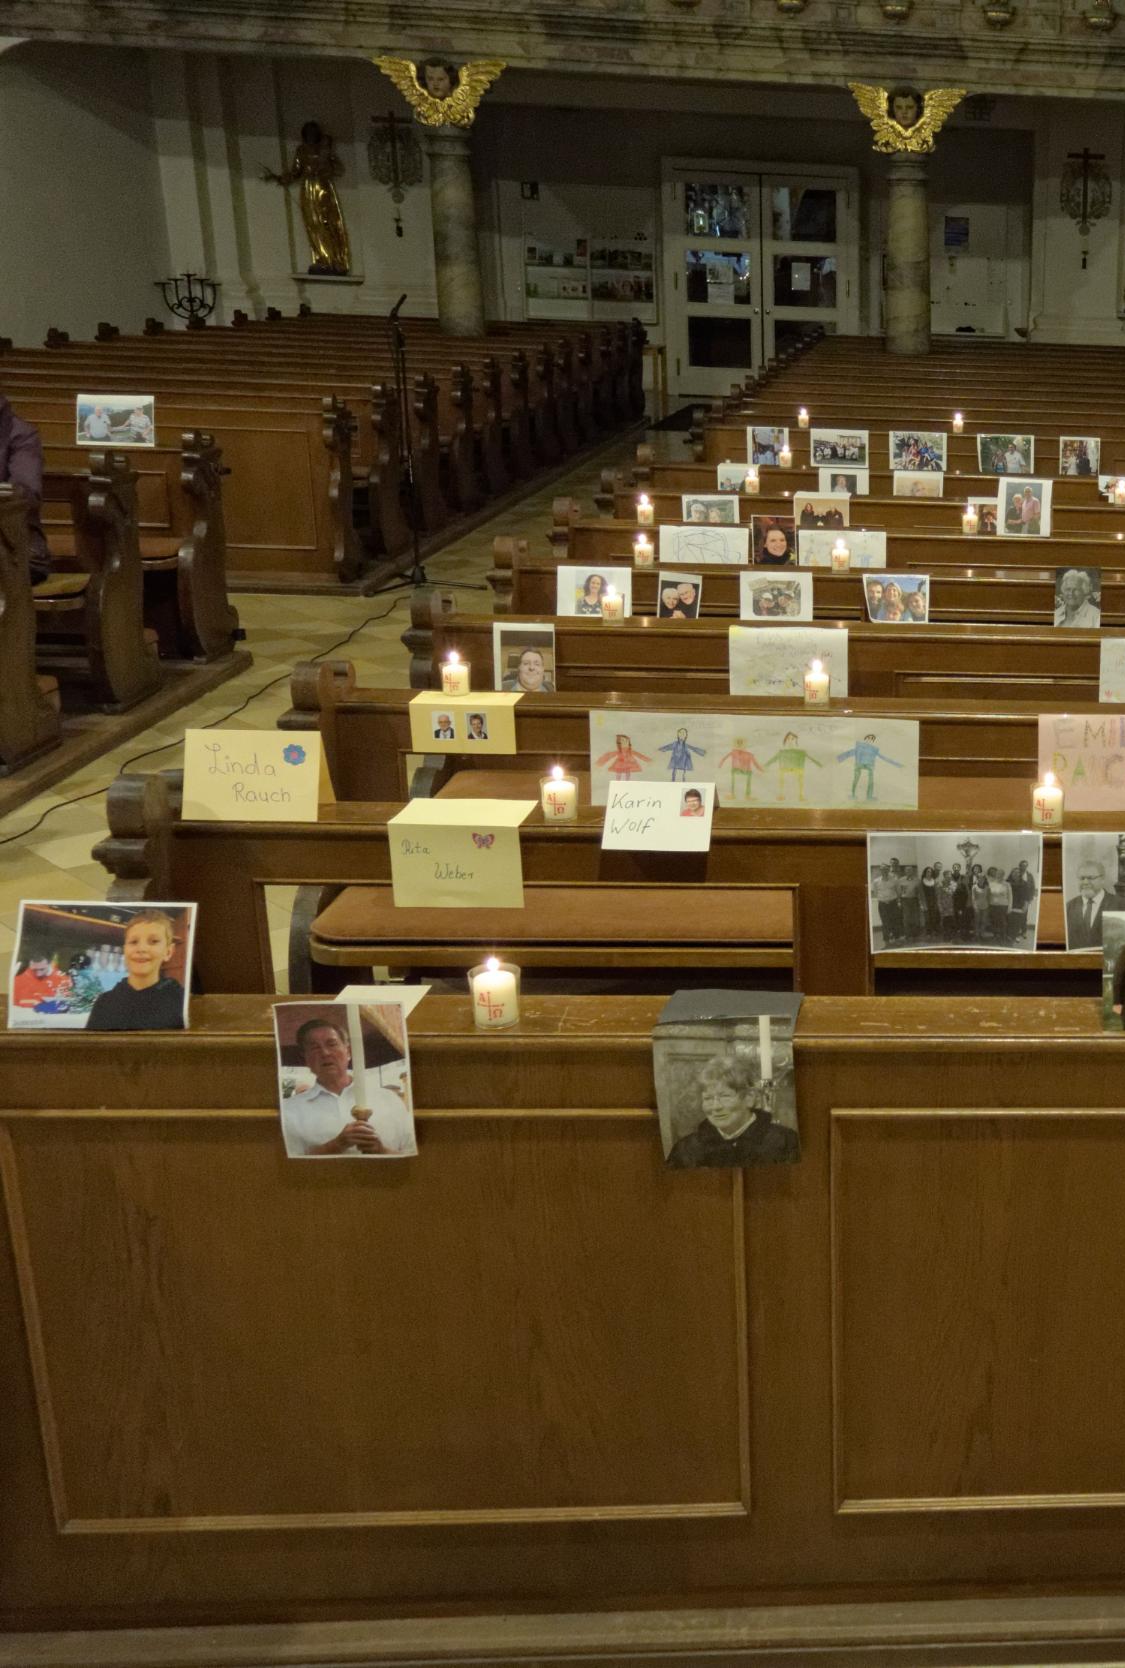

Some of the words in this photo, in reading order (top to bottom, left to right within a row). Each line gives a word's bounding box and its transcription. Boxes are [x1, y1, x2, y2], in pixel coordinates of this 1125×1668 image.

[204, 743, 277, 776] Linda
[232, 782, 291, 802] Rauch
[611, 792, 662, 809] Karin
[610, 817, 655, 834] Wolf
[401, 838, 430, 855] Rita
[434, 862, 474, 880] Weber
